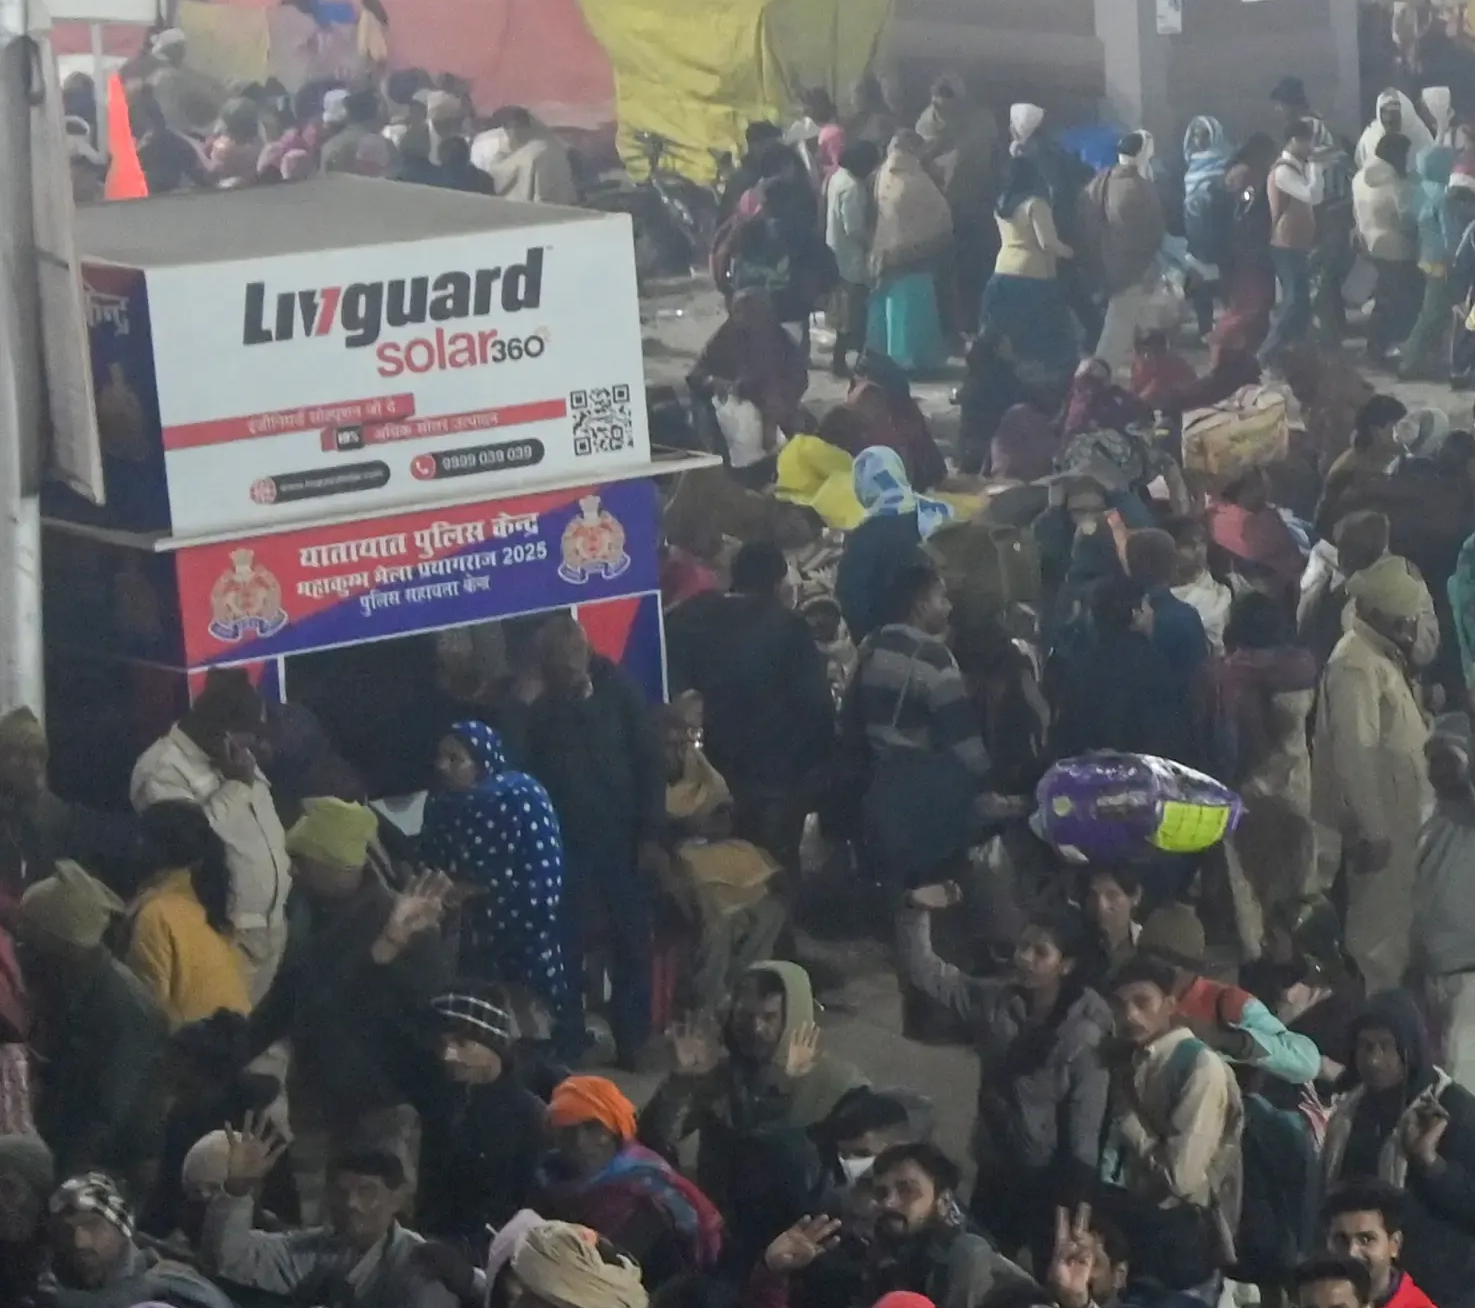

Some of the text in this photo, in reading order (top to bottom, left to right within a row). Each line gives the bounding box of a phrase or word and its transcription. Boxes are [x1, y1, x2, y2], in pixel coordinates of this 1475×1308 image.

[243, 246, 545, 348] Livguard
[298, 512, 541, 568] यातायात पुलिस केन्द्र
[502, 541, 548, 566] 2025
[359, 587, 401, 617] पुलिस
